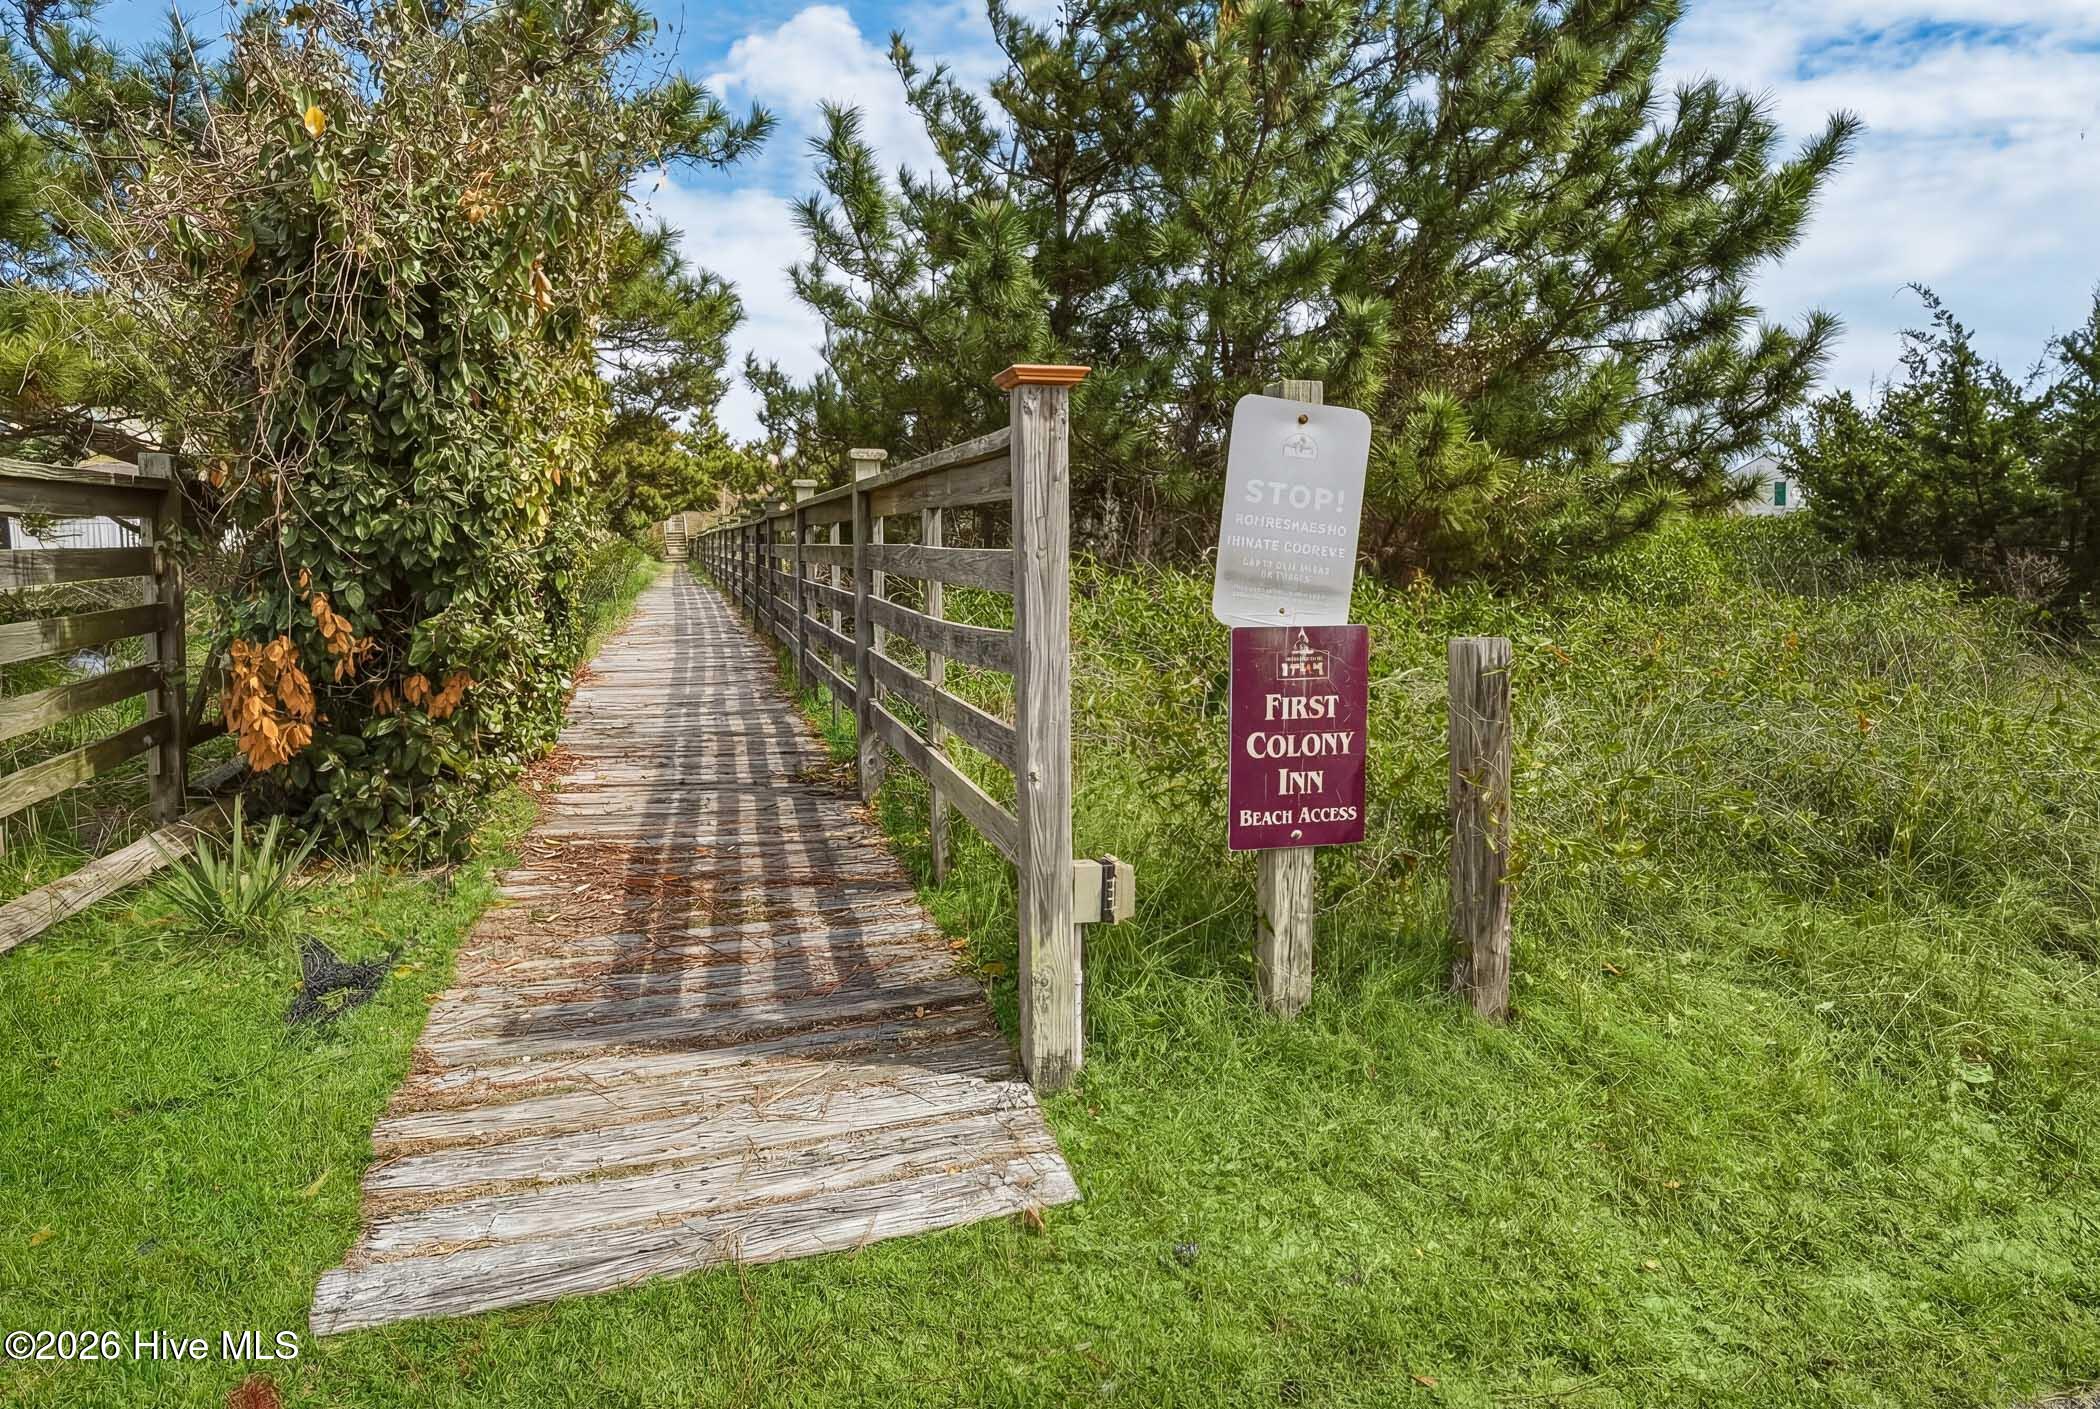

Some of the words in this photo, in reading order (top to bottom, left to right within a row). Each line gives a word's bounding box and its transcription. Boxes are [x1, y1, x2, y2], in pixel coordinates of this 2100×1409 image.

[1245, 479, 1345, 513] STOP!
[1265, 694, 1339, 720] FIRST
[1246, 731, 1355, 759] COLONY
[1278, 768, 1324, 795] INN
[1239, 810, 1292, 826] BEACH
[1298, 806, 1358, 824] ACCESS
